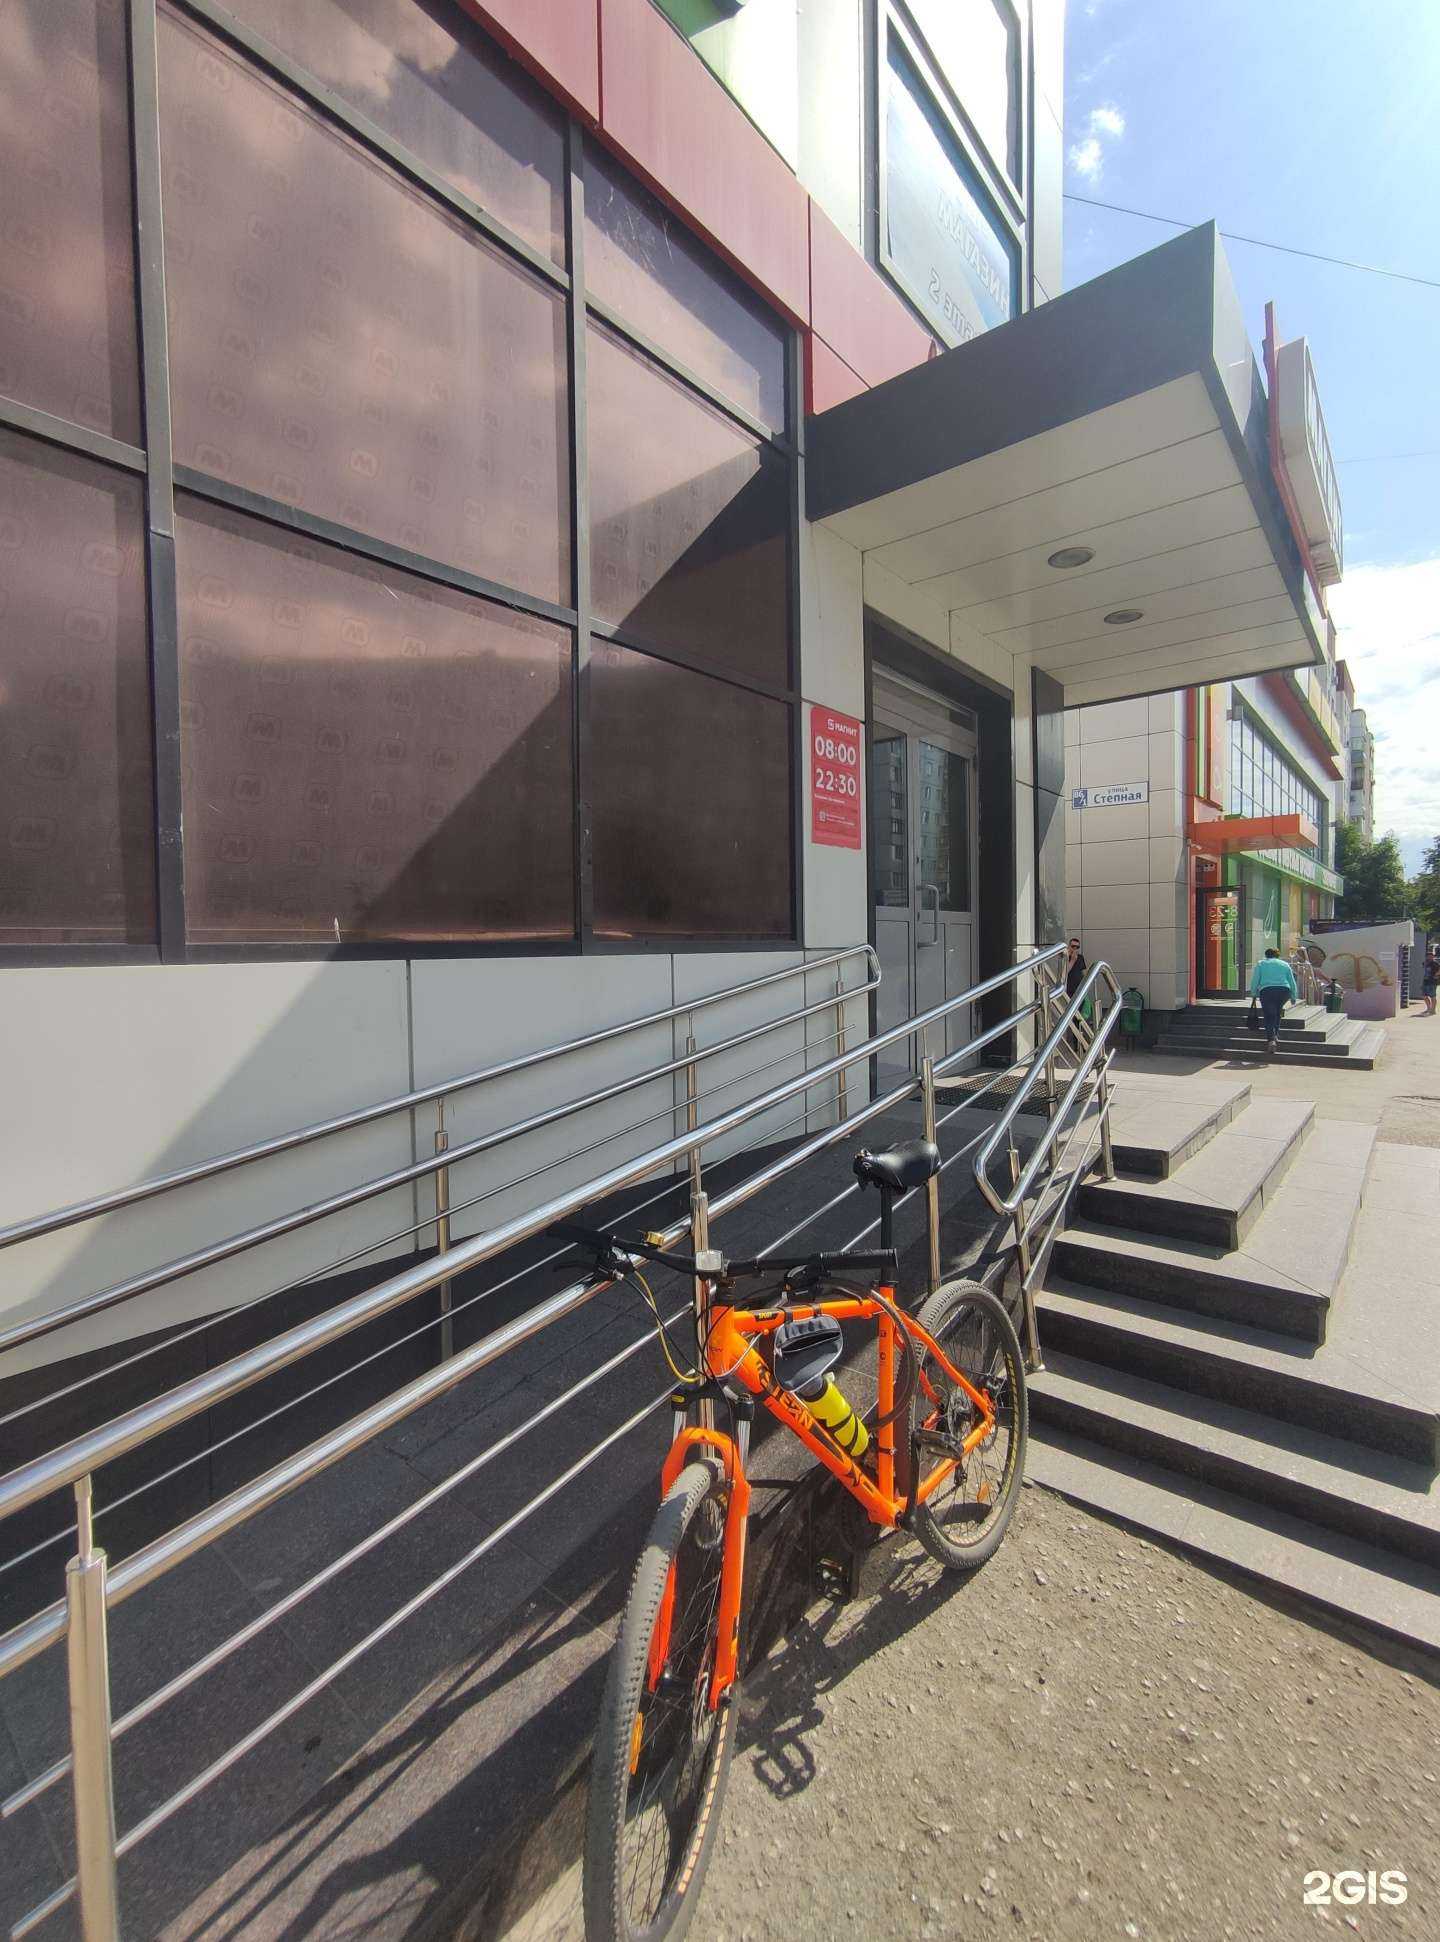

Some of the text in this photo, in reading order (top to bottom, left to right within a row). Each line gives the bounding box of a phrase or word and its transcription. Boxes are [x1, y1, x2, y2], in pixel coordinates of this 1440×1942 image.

[928, 268, 941, 305] 2
[815, 735, 857, 766] 08:00
[815, 767, 857, 797] 22:30
[1093, 792, 1142, 804] Степная
